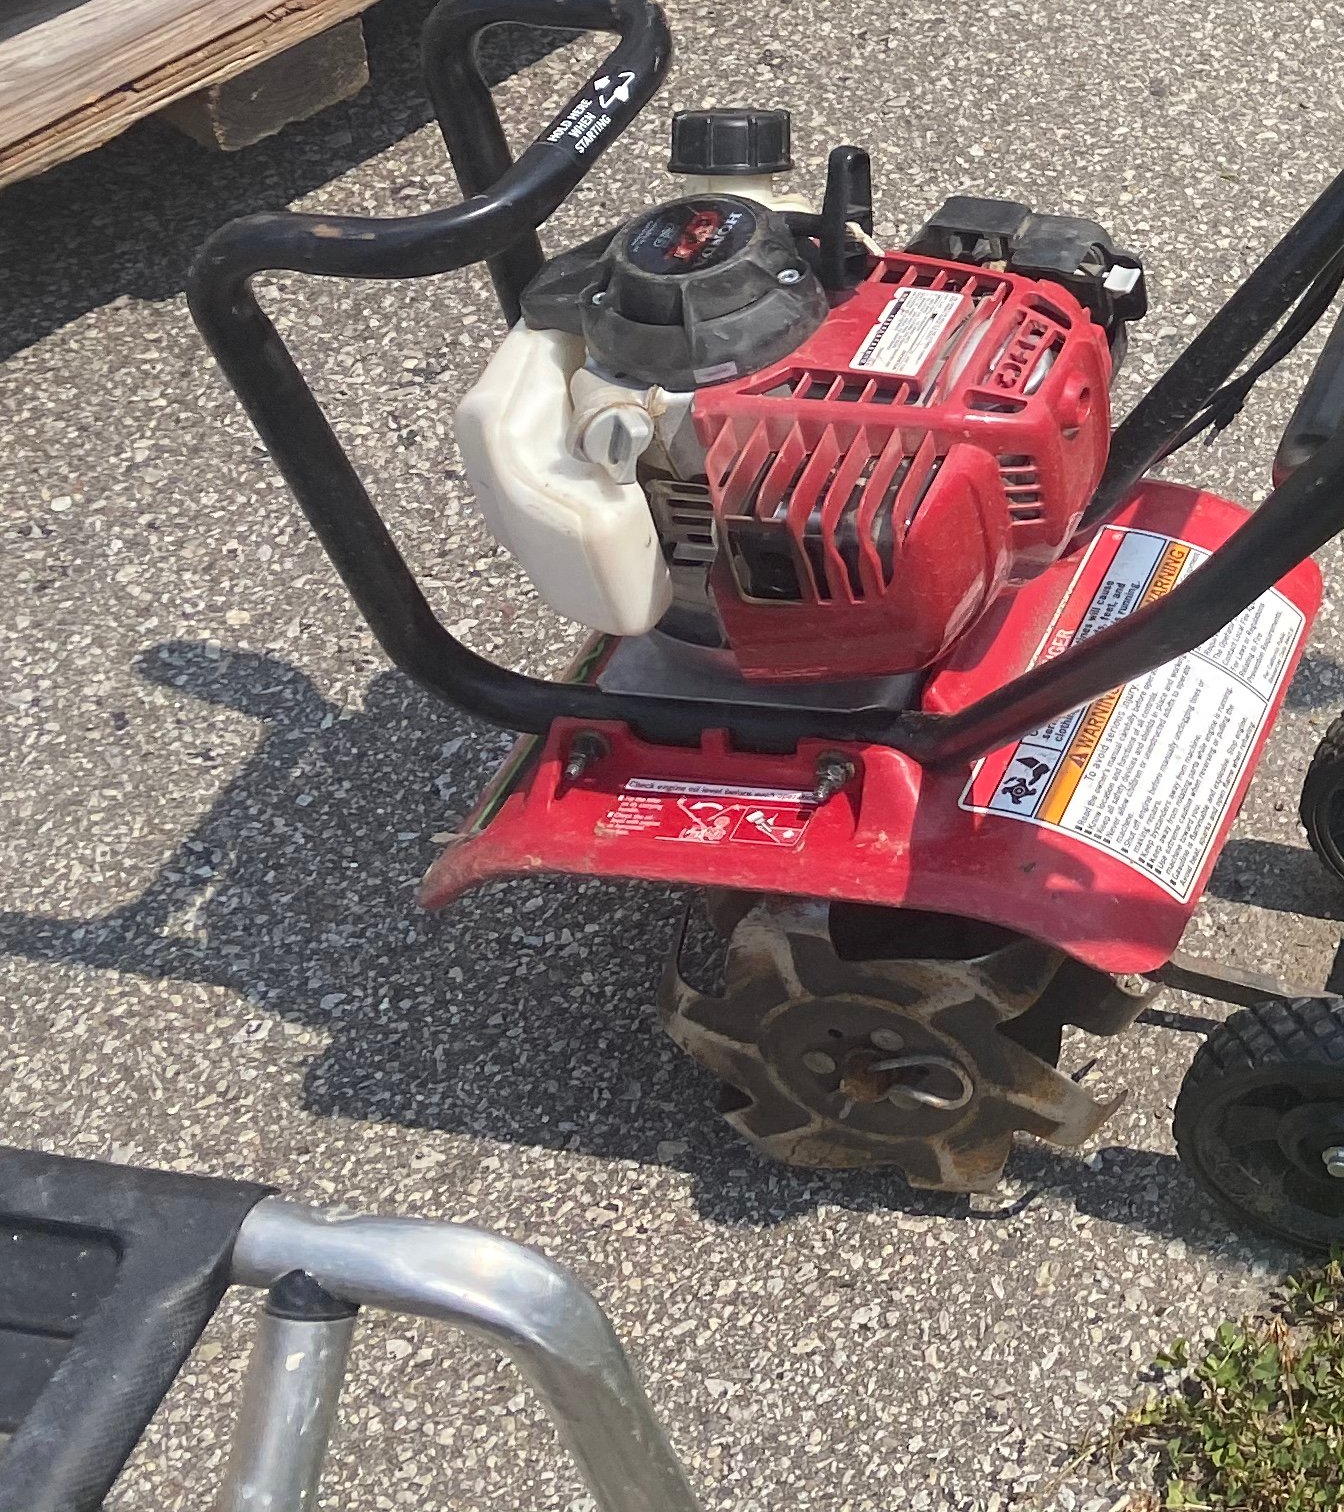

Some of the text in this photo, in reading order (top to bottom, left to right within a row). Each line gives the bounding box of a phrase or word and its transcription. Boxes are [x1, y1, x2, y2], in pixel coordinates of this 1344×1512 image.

[546, 98, 592, 141] HOLD HERE
[567, 111, 596, 137] WHEN
[574, 113, 611, 154] STARTING
[1087, 606, 1099, 621] will
[1097, 579, 1113, 605] cause
[1112, 581, 1124, 598] and
[1232, 625, 1243, 641] Local
[1252, 631, 1262, 644] Fire
[1077, 806, 1091, 825] Read
[1086, 793, 1098, 806] the
[1105, 742, 1121, 766] manual
[1117, 712, 1136, 741] carefully
[1131, 690, 1145, 711] before
[1084, 768, 1095, 782] To
[1092, 744, 1108, 768] avoid
[1104, 710, 1124, 742] serious
[1098, 782, 1114, 809] location
[1110, 766, 1122, 781] and
[1117, 736, 1135, 766] functions
[1135, 718, 1144, 728] all
[1106, 804, 1115, 814] all
[1111, 784, 1125, 804] safety
[1121, 756, 1137, 781] devices
[1133, 741, 1144, 756] and
[1140, 719, 1154, 741] shields
[1154, 692, 1168, 710] place
[1162, 677, 1174, 691] and
[1106, 817, 1119, 838] Never
[1117, 798, 1128, 815] allow
[1176, 664, 1192, 689] operate
[1124, 831, 1135, 846] Shut
[1137, 796, 1152, 819] engine
[1148, 772, 1162, 794] before
[1158, 741, 1177, 771] manually
[1173, 704, 1194, 740] unclogging
[1141, 839, 1154, 857] Keep
[1149, 800, 1171, 838] bystanders
[1168, 781, 1180, 799] away
[1176, 763, 1187, 779] from
[1149, 845, 1162, 863] Keep
[1159, 825, 1171, 843] away
[1167, 807, 1178, 823] from
[1175, 780, 1191, 806] rotating
[1187, 761, 1199, 778] parts
[1196, 743, 1207, 759] while
[1204, 720, 1218, 741] engine
[1156, 854, 1168, 869] Use
[1164, 824, 1181, 853] extreme
[1177, 798, 1192, 823] caution
[1189, 779, 1201, 796] when
[1197, 747, 1216, 778] reversing
[1215, 716, 1230, 737] pulling
[1224, 703, 1235, 715] the
[1207, 806, 1218, 821] and
[1214, 789, 1226, 806] open
[1230, 751, 1242, 767] when
[1133, 827, 1149, 852] making
[1165, 844, 1182, 874] machine
[1179, 819, 1193, 842] toward
[1172, 849, 1190, 879] Gasoline
[1205, 788, 1216, 803] and
